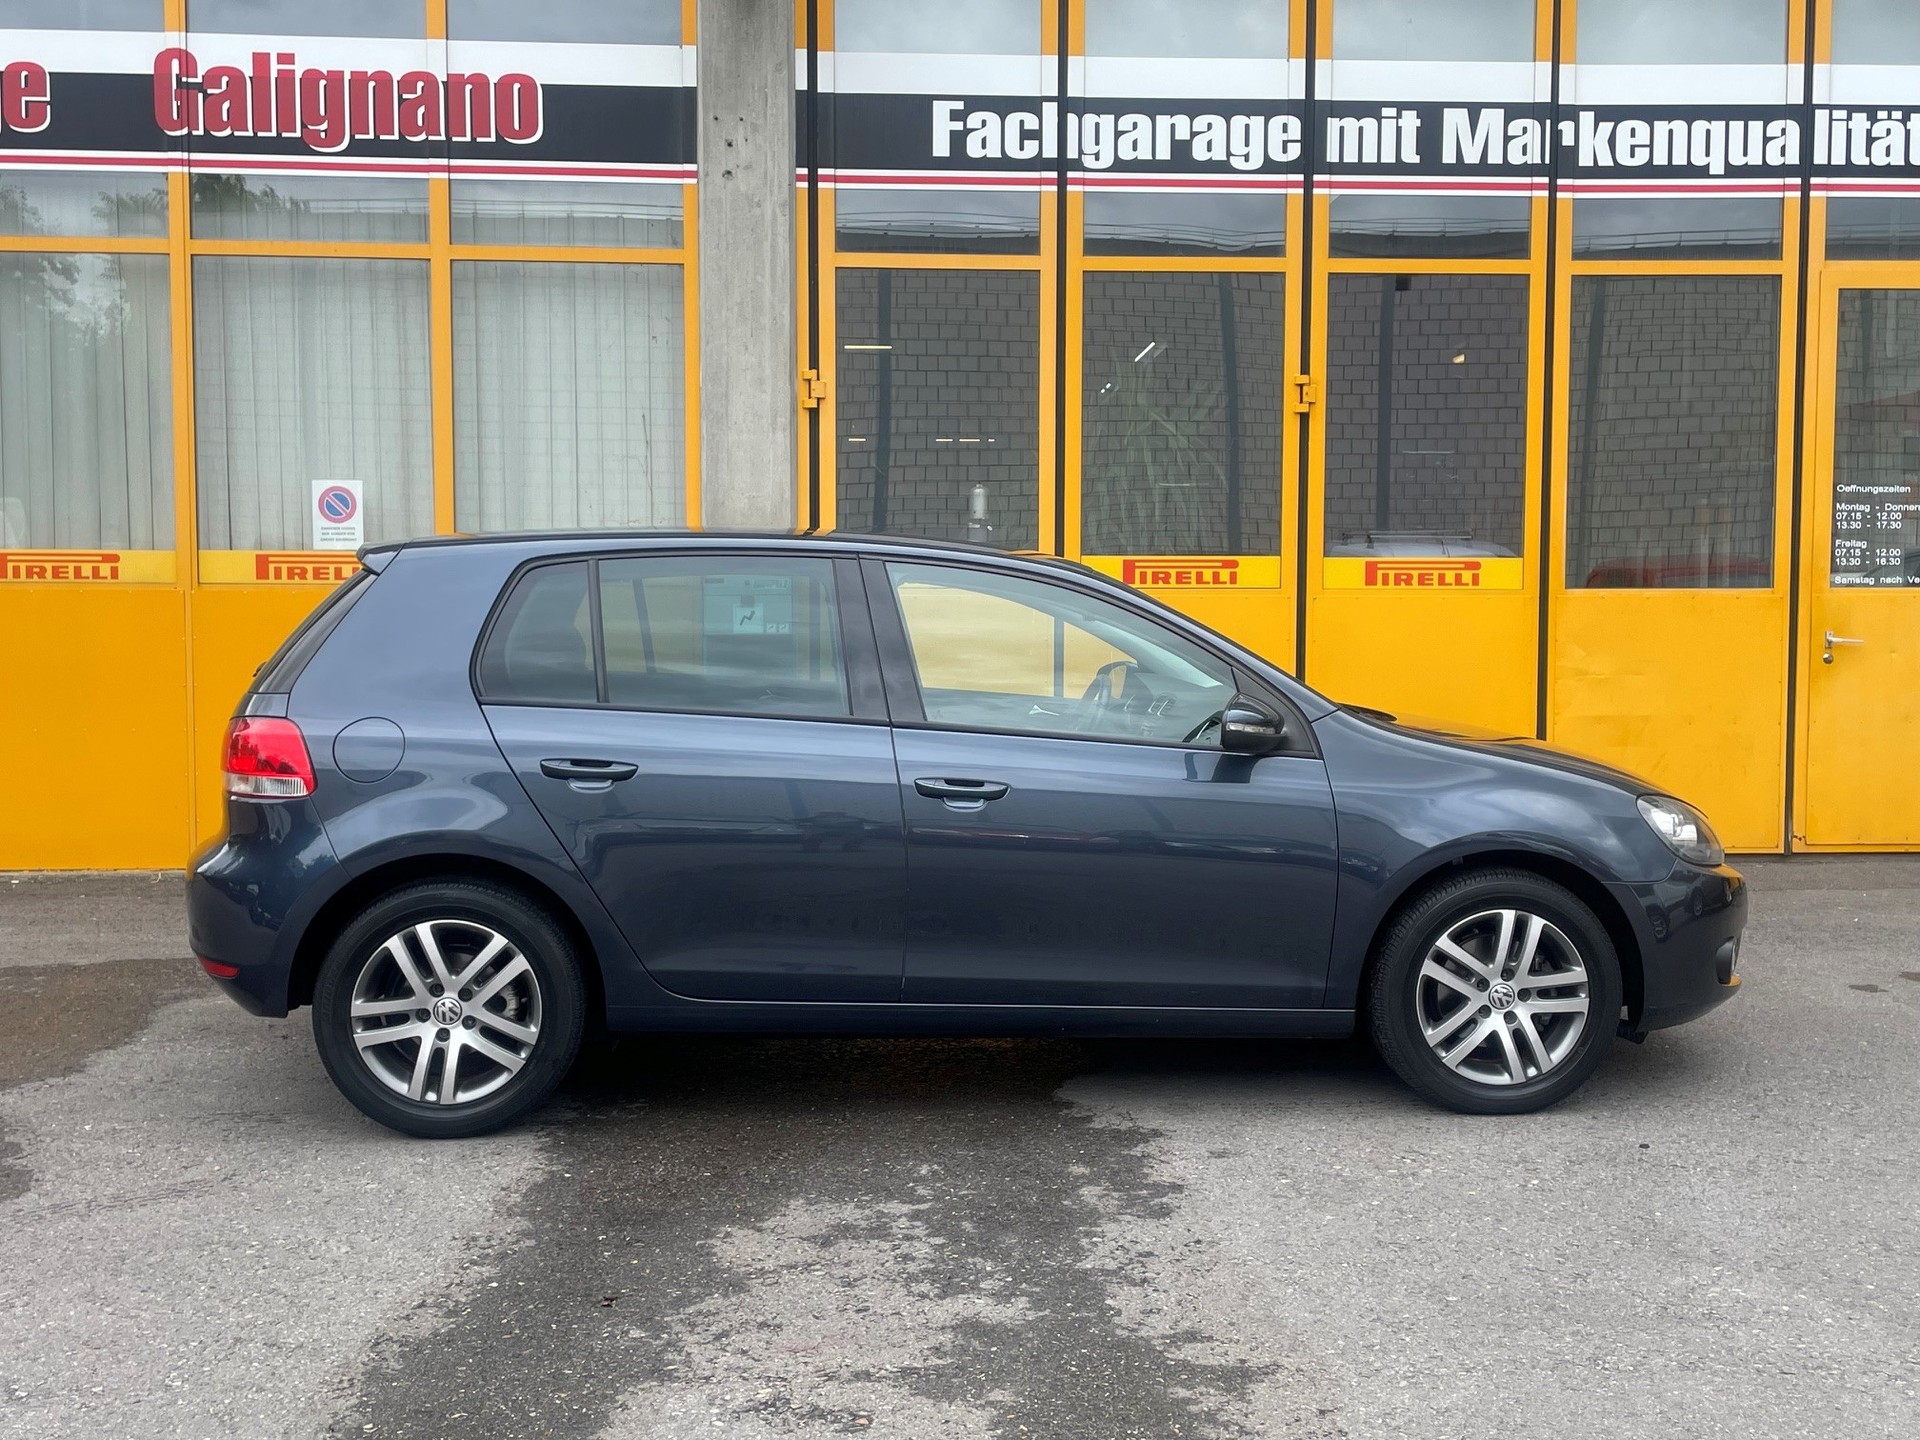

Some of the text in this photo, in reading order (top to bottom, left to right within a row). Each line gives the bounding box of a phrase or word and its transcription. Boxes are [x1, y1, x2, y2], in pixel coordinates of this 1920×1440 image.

[0, 47, 543, 153] e Galignano
[932, 100, 1920, 175] Fachgarage mit Markenqualität
[1836, 484, 1911, 494] Oeffnungszeiten
[1836, 503, 1871, 512] Montag
[1835, 512, 1862, 520] 07.15
[1876, 512, 1902, 520] 12.00
[1836, 521, 1862, 529] 13.30
[1876, 521, 1902, 529] 17.30
[1835, 539, 1867, 549] Freitag
[1835, 548, 1861, 556] 07.15
[1875, 548, 1901, 556] 12.00
[0, 553, 120, 579] PIRELLI
[1835, 557, 1861, 565] 13.30
[256, 554, 361, 580] PIREL
[1123, 559, 1239, 584] PIRELLI
[1365, 561, 1481, 586] PIRELLI
[1834, 575, 1875, 585] Samstag
[1880, 575, 1902, 584] nach
